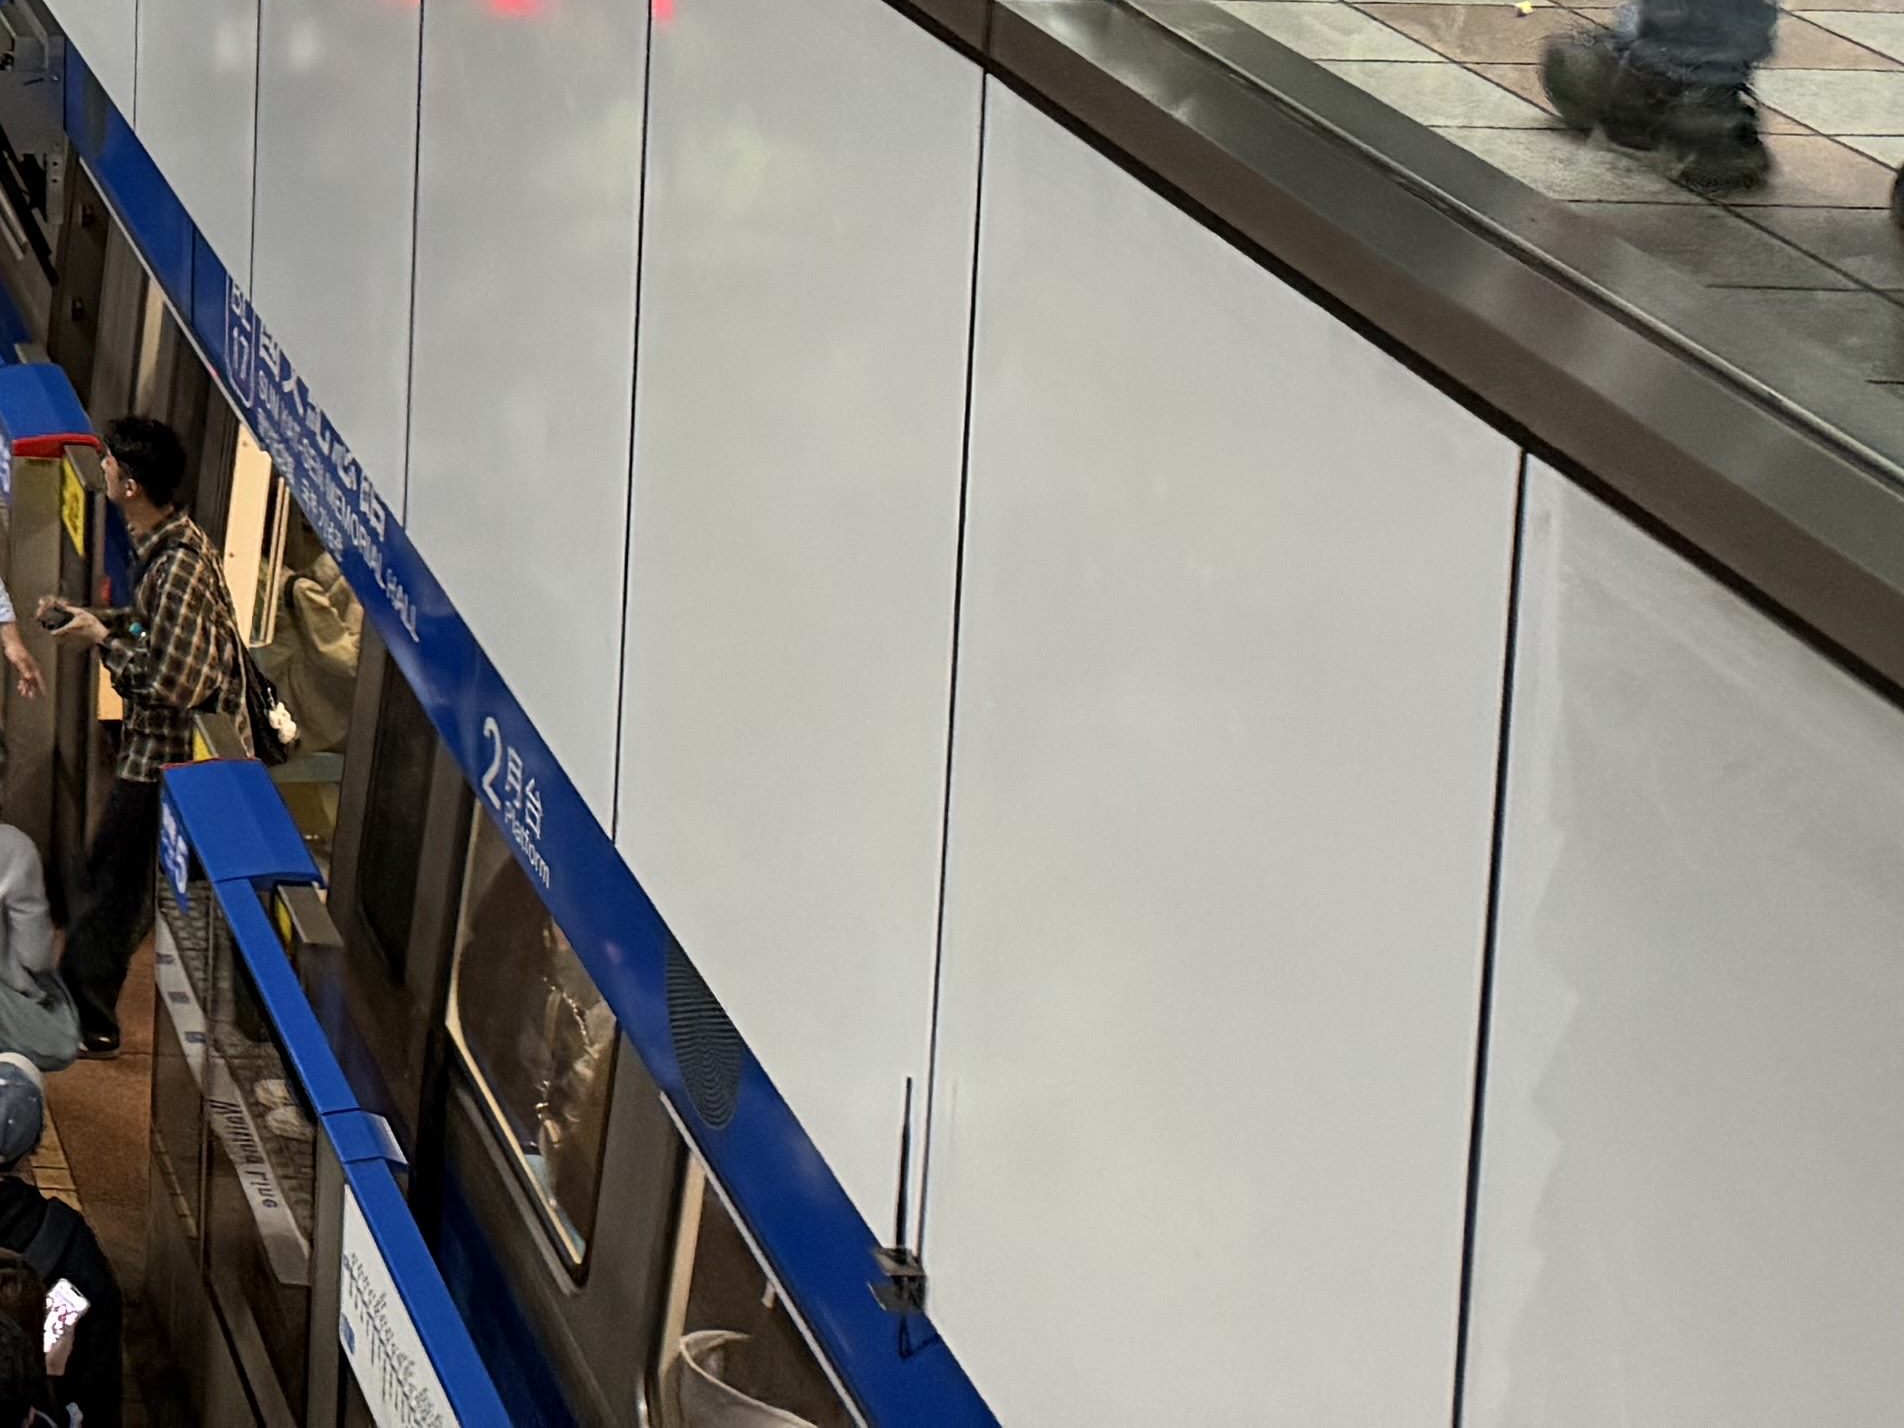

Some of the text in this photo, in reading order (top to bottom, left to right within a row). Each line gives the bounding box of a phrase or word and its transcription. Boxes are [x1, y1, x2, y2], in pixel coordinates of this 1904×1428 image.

[482, 716, 544, 840] 2 月台
[504, 800, 551, 889] Platform
